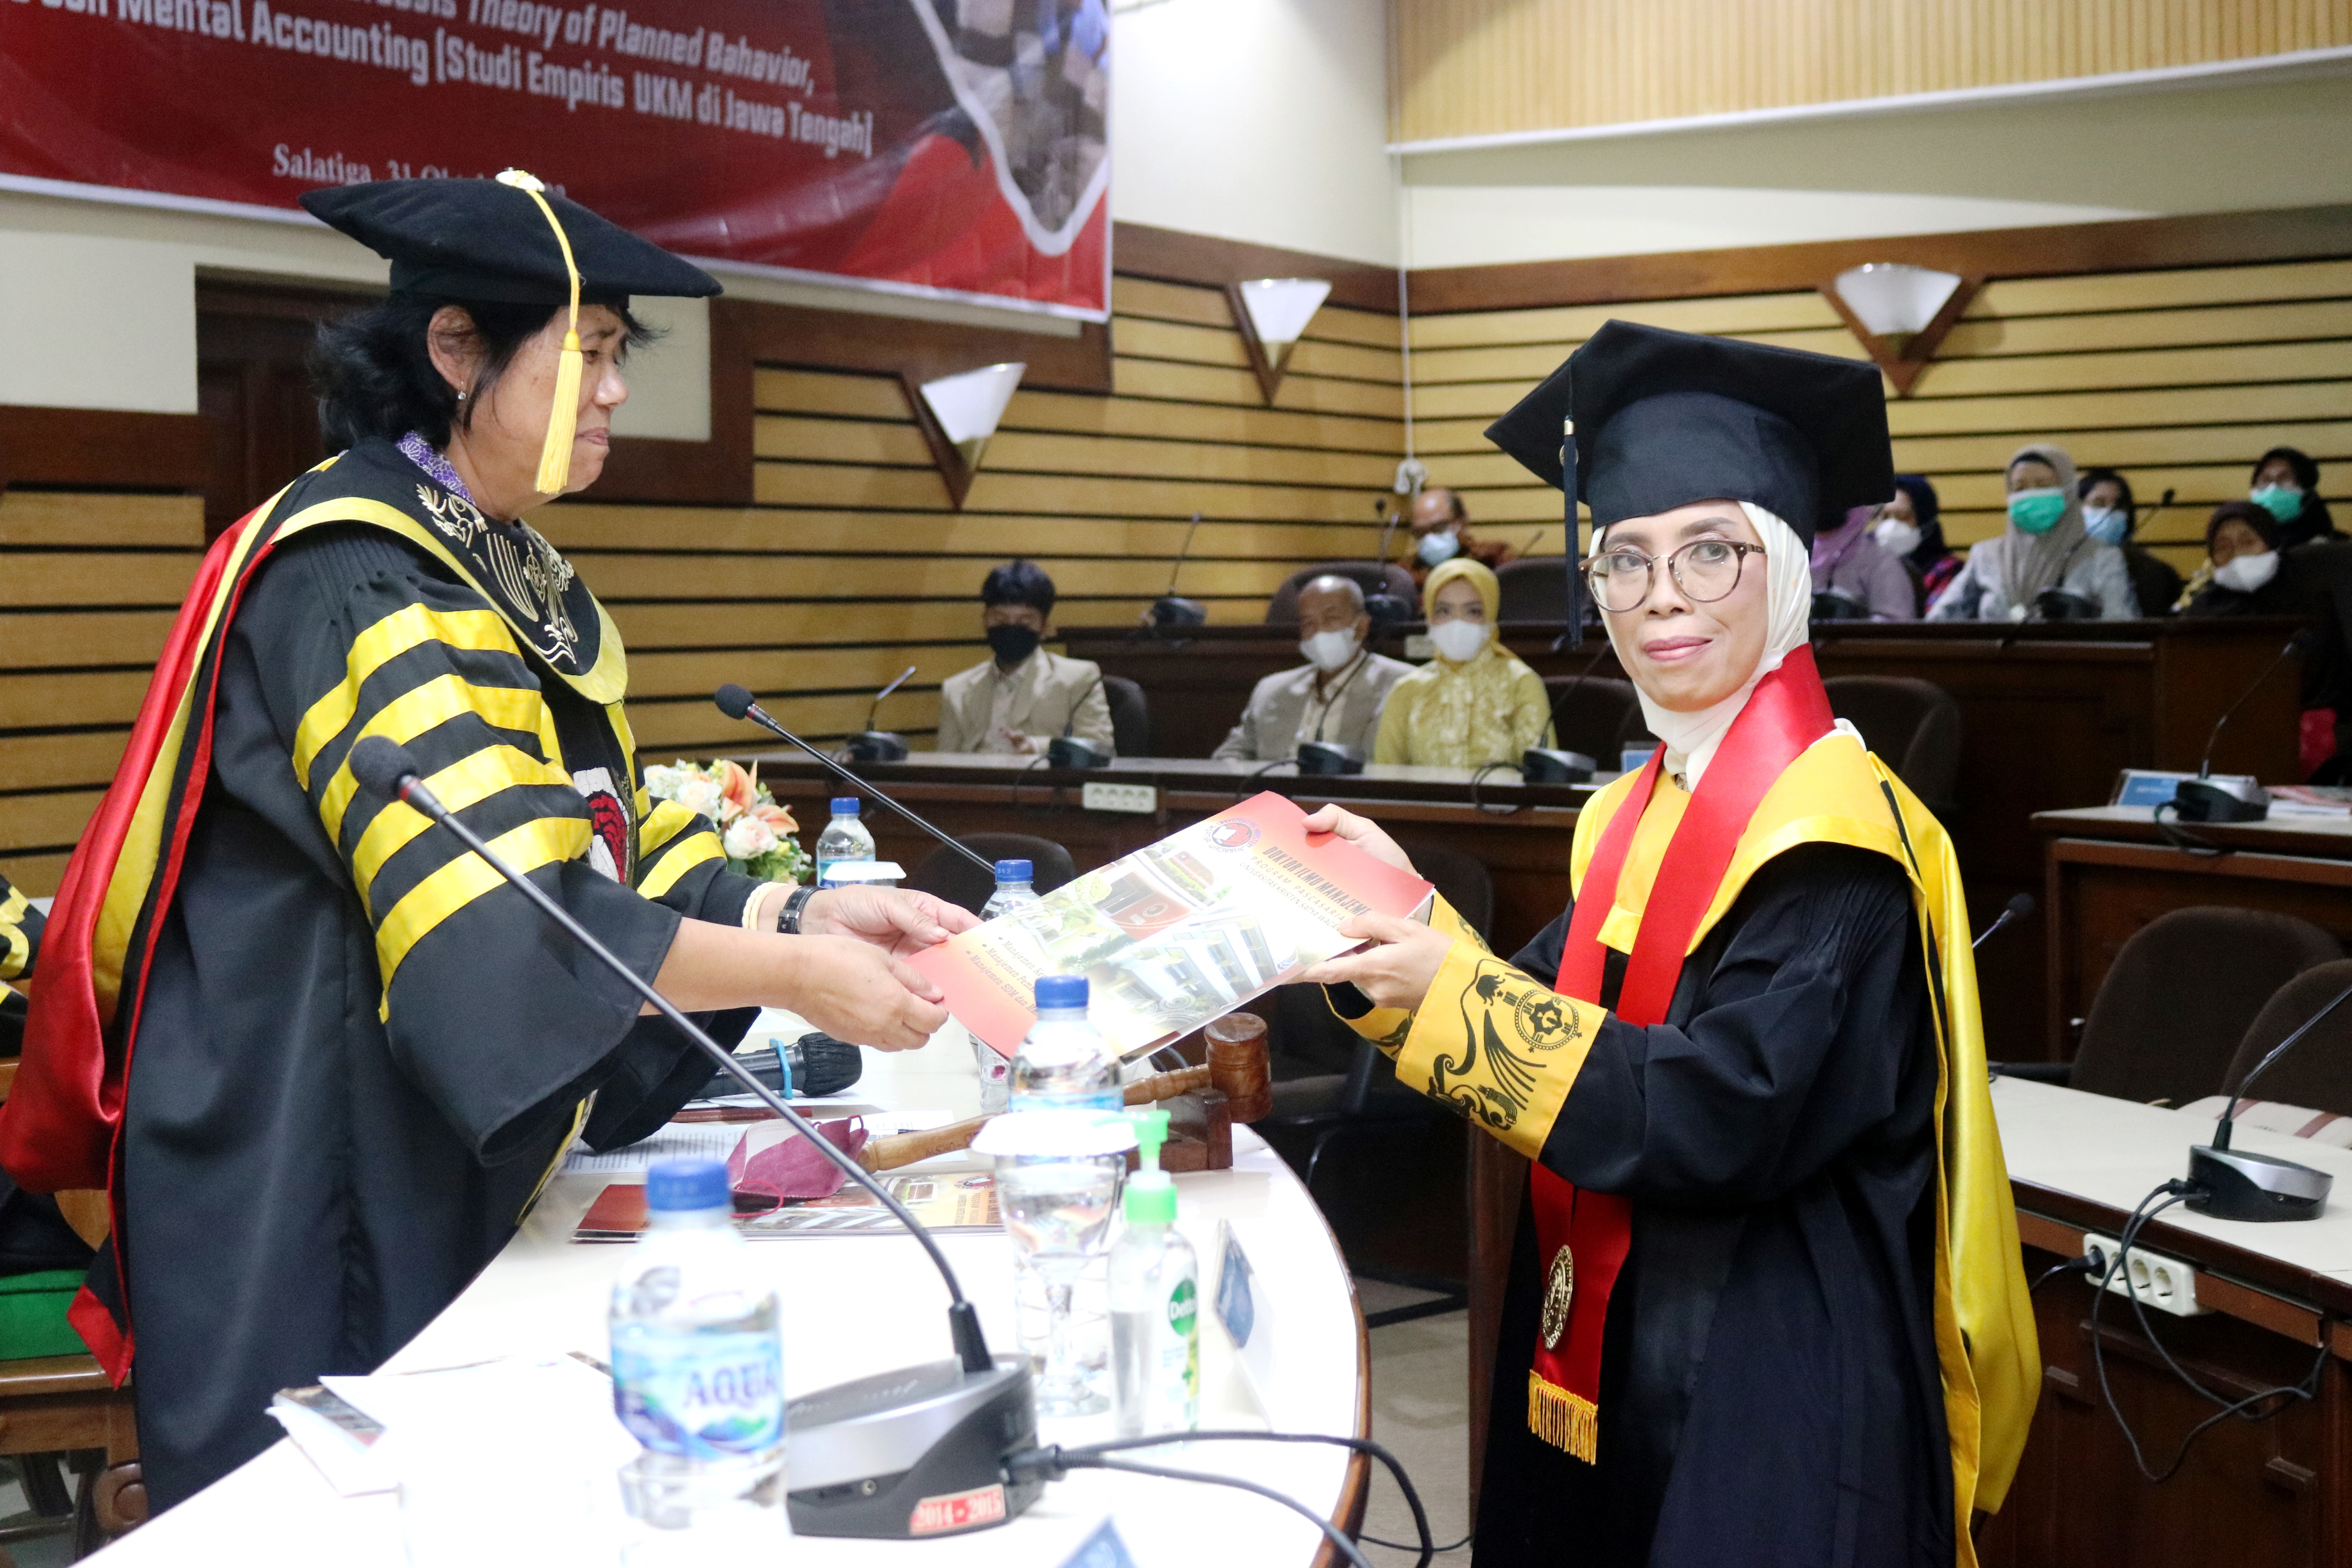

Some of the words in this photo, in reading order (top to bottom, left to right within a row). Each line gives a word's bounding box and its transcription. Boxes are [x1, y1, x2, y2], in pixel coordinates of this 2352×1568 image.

[118, 0, 246, 41] Mental
[251, 0, 430, 86] Accounting
[526, 50, 625, 112] Empiris
[633, 71, 693, 119] UKM
[696, 82, 720, 125] di
[723, 89, 784, 138] Jawa
[564, 4, 597, 45] of
[597, 6, 705, 67] Planned
[706, 31, 815, 98] Bahavior,
[1240, 862, 1278, 888] UNIVERSITAS
[1275, 884, 1302, 905] KRISTEN
[1299, 902, 1319, 917] SATYA
[1250, 857, 1292, 884] PROGRAM
[1293, 885, 1346, 922] PASCASARJA
[1262, 846, 1303, 872] DOKTOR
[1294, 867, 1325, 886] ILMU
[969, 955, 1003, 985] Manajemen
[1001, 984, 1019, 997] SDM
[1014, 996, 1028, 1006] dan
[985, 948, 1019, 978] Manajemen
[1002, 940, 1036, 970] Manajemen
